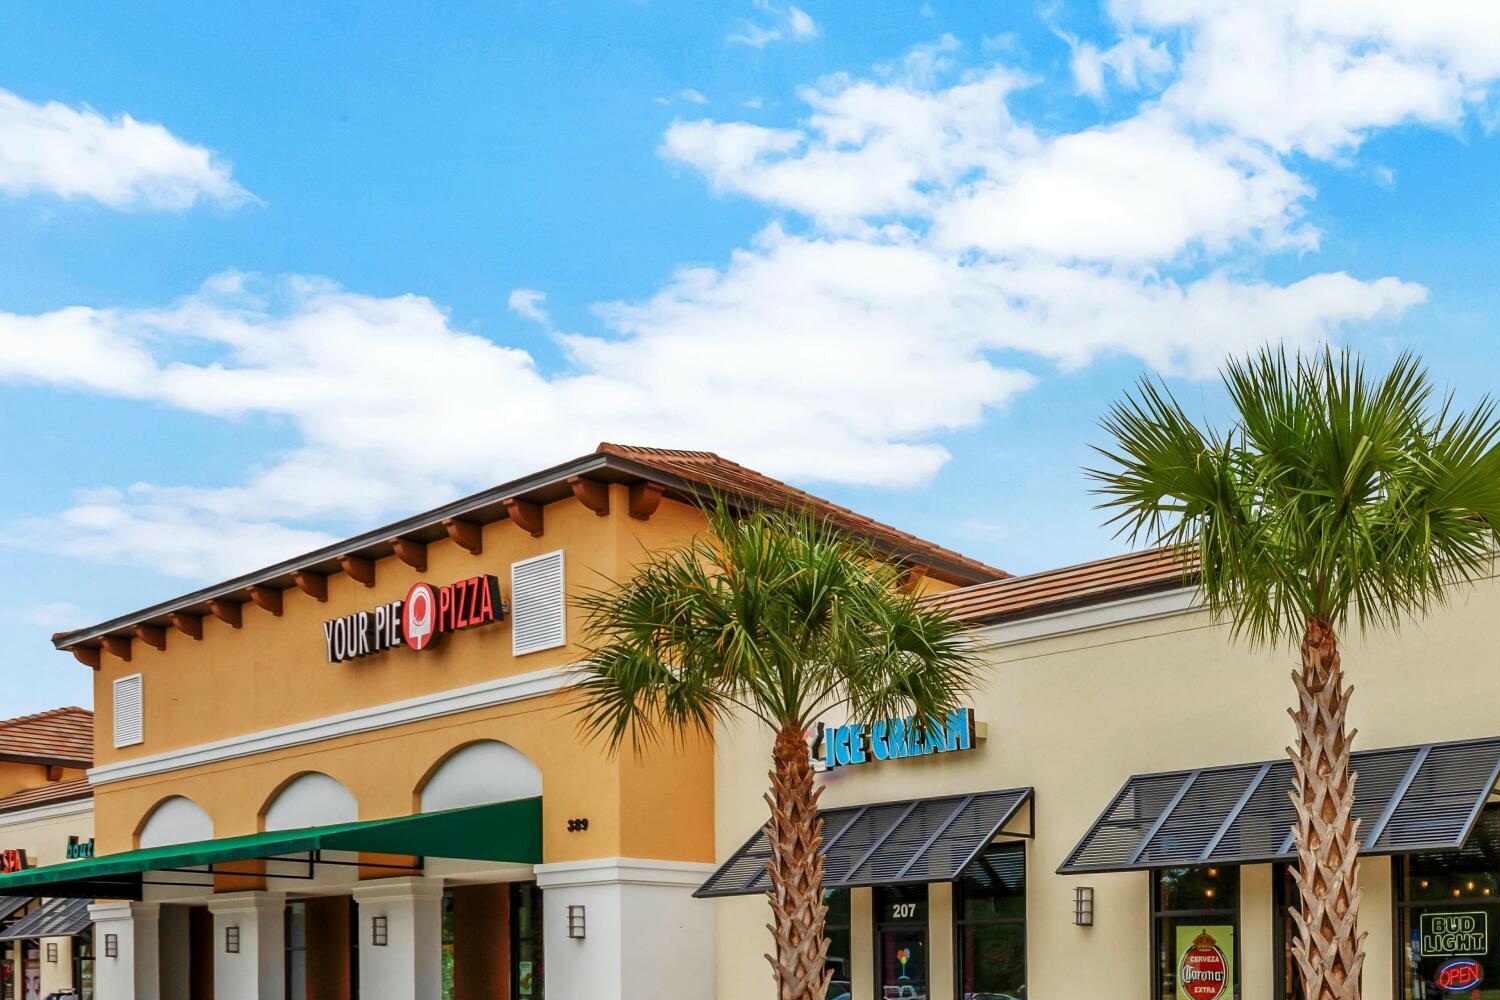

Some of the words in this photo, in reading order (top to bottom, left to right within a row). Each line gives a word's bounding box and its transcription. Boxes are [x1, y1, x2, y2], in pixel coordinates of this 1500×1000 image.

[322, 611, 370, 663] YOUR
[375, 600, 401, 650] PIE
[439, 574, 495, 633] PIZZA
[825, 723, 866, 767] ICE
[872, 707, 971, 761] CREAM
[567, 818, 589, 833] 389
[66, 838, 94, 859] bout
[892, 903, 916, 918] 207
[1431, 916, 1476, 934] BUD
[1423, 933, 1484, 953] LIGHT
[1189, 955, 1220, 963] CERVEZA
[1182, 964, 1225, 984] Corona
[1438, 961, 1479, 988] OPEN
[1194, 986, 1216, 994] EXTRA
